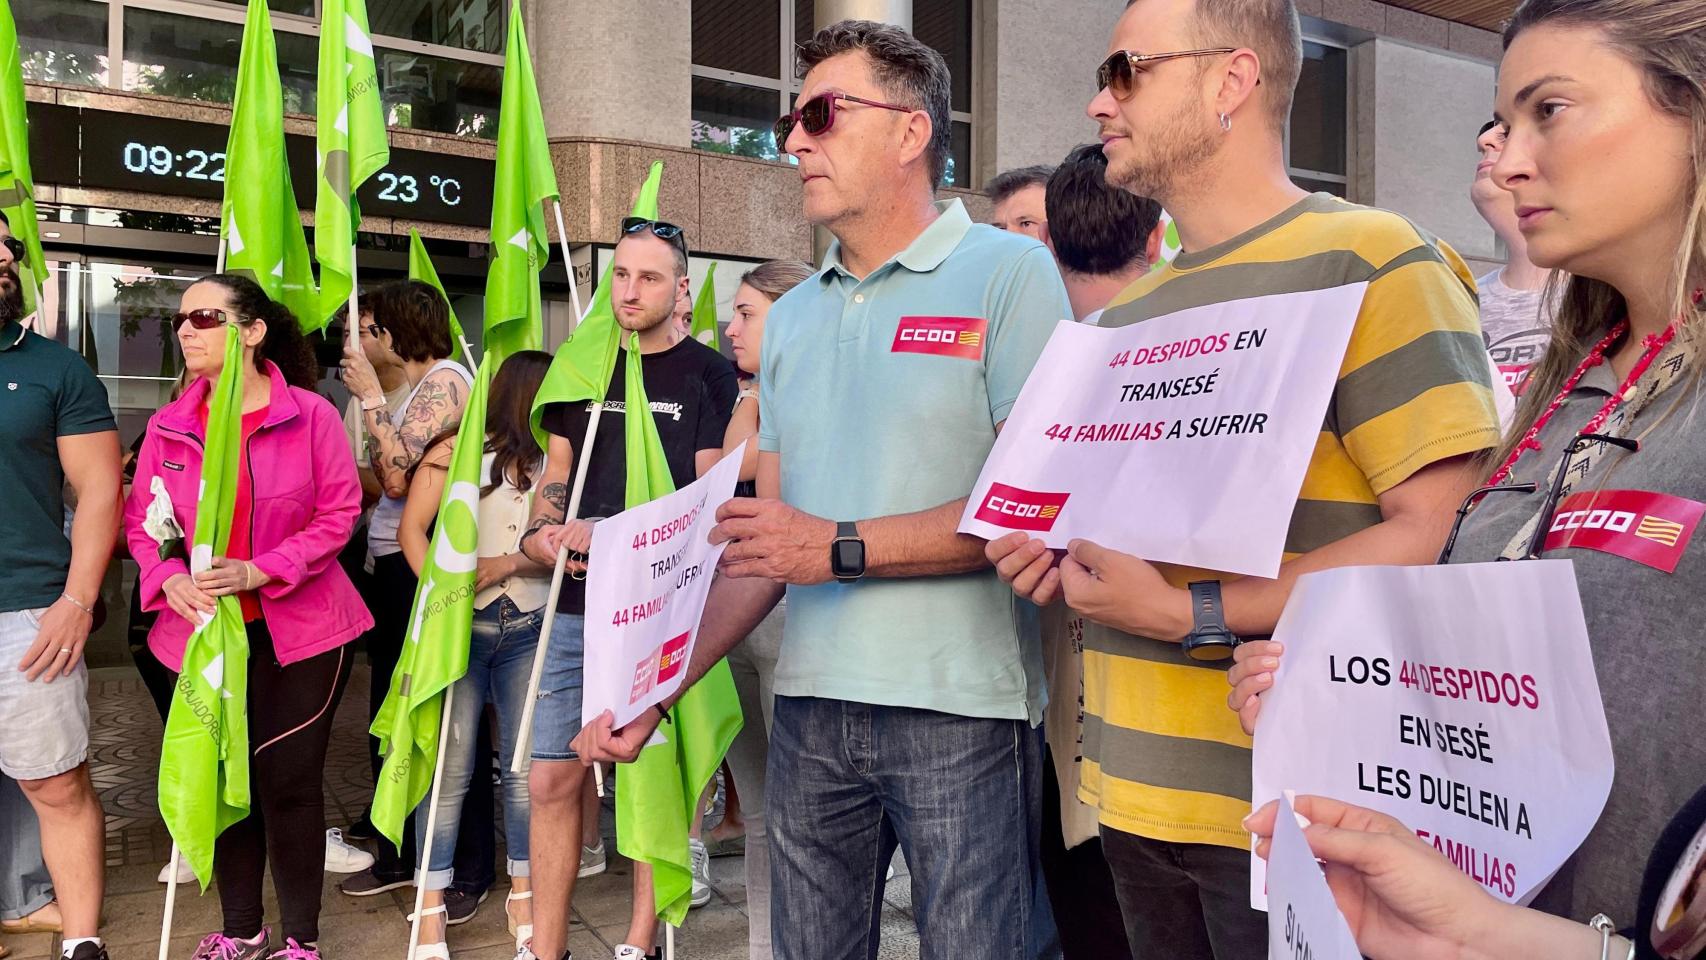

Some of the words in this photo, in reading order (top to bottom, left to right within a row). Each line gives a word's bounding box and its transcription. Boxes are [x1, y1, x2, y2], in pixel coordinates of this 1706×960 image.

[124, 142, 227, 182] 09:22
[378, 173, 418, 203] 23
[900, 328, 956, 344] CCOO
[1109, 350, 1131, 369] 44
[1132, 332, 1230, 366] DESPIDOS
[1233, 328, 1267, 350] EN
[1120, 368, 1220, 402] TRANSESÉ
[1044, 423, 1073, 442] 44
[1073, 421, 1165, 442] FAMILIAS
[1166, 419, 1182, 440] A
[1186, 412, 1268, 438] SUFRIR
[986, 495, 1041, 517] CCOO
[1549, 509, 1636, 533] CCOO
[632, 532, 647, 550] 44
[612, 609, 629, 627] 44
[1329, 655, 1391, 686] LOS
[1399, 660, 1419, 690] 44
[1419, 664, 1539, 710] DESPIDOS
[1400, 714, 1431, 748] EN
[1434, 722, 1493, 764] SESÉ
[1358, 762, 1411, 800] LES
[1419, 773, 1509, 831] DUELEN
[1515, 802, 1532, 840] A
